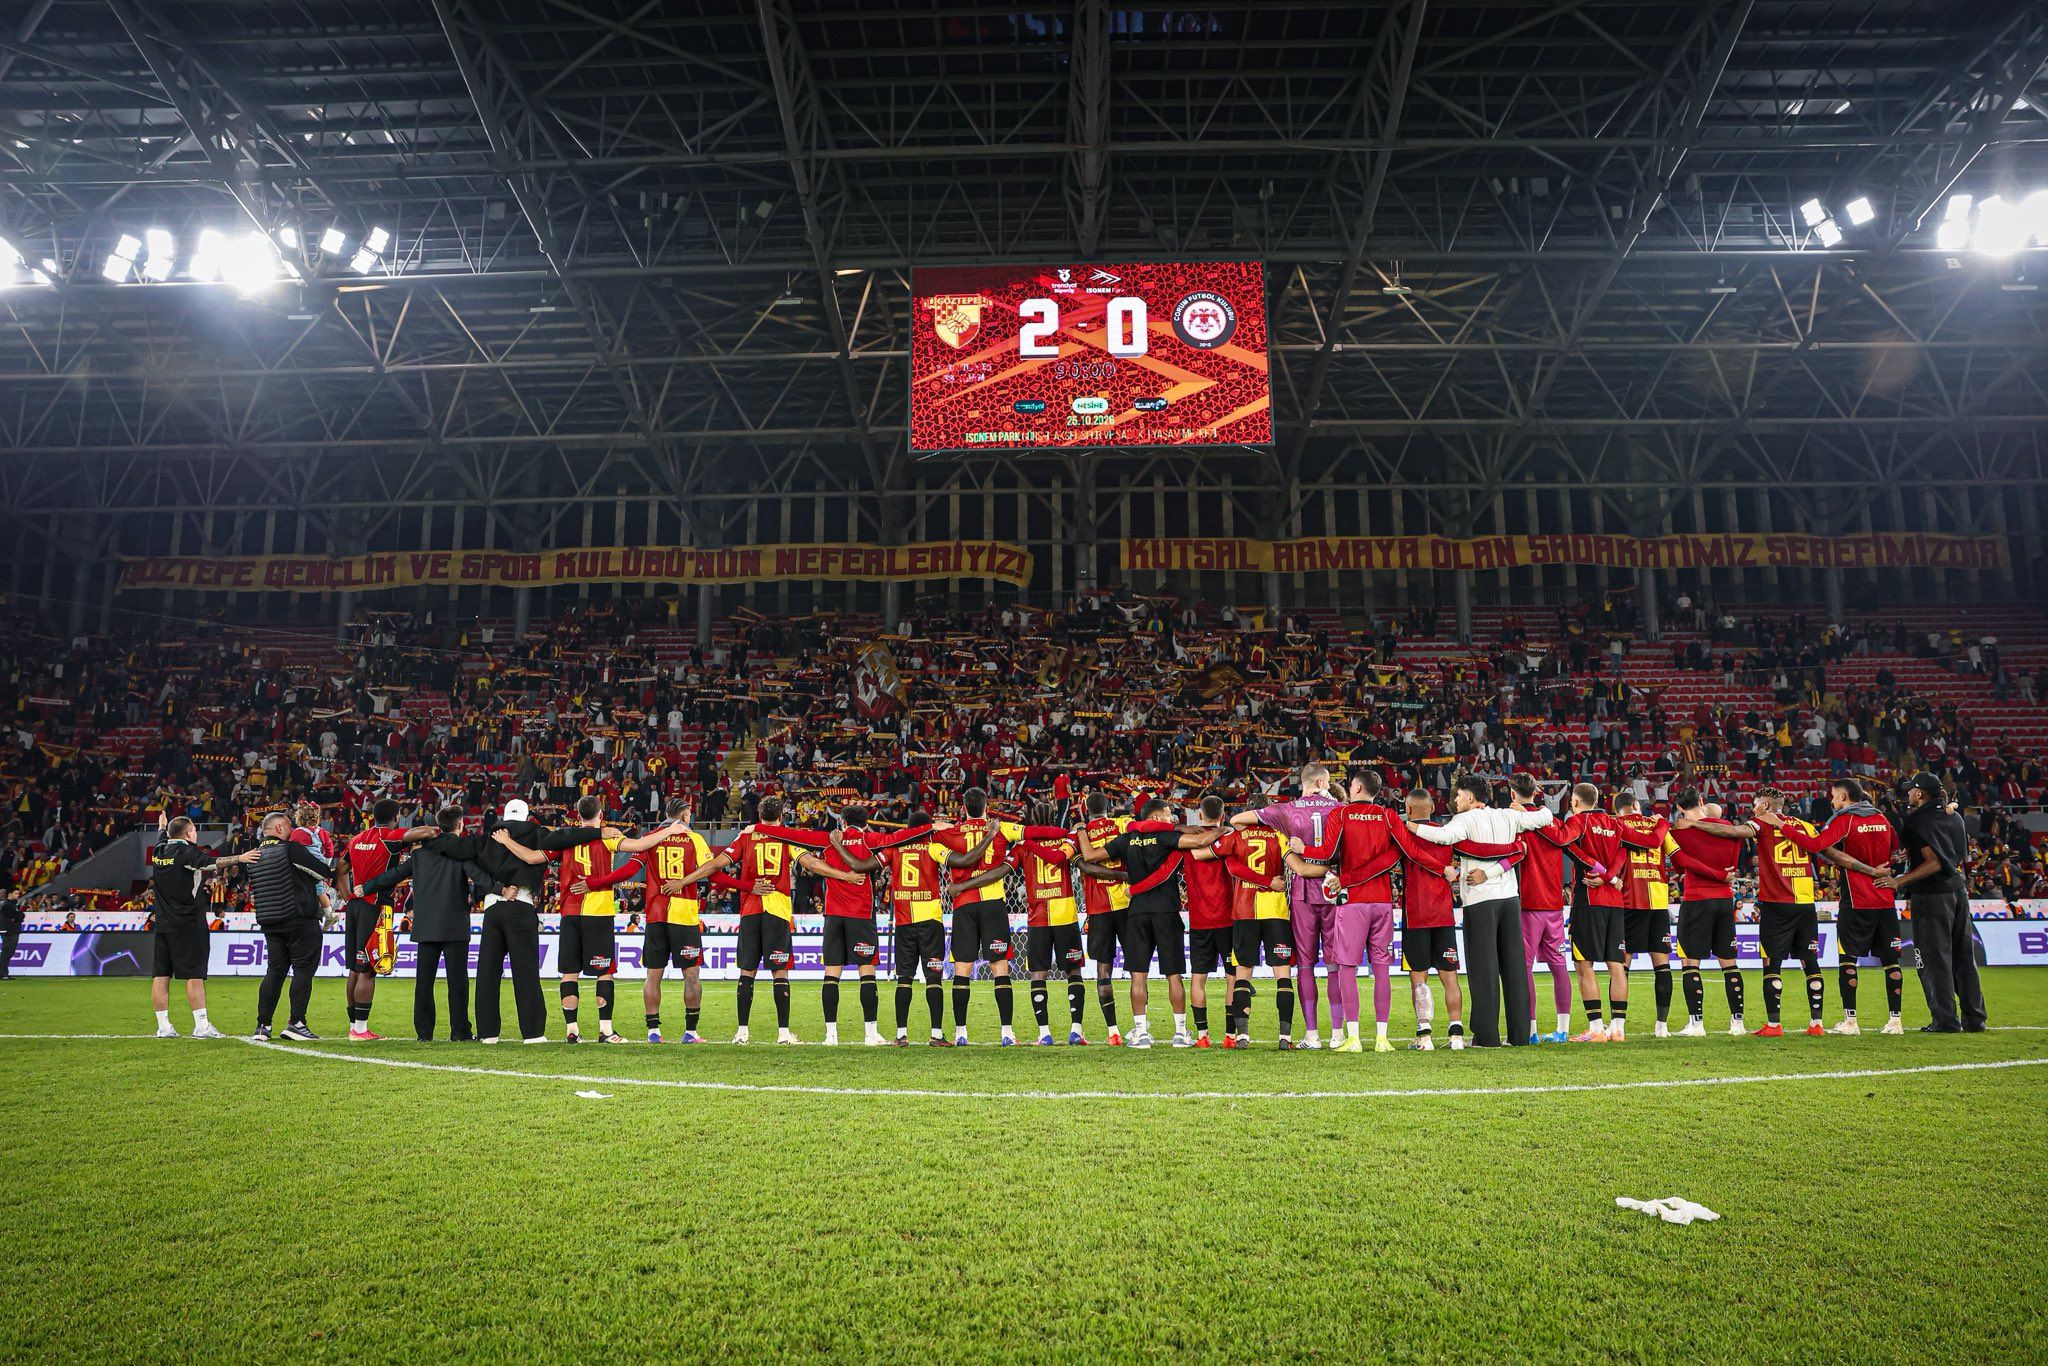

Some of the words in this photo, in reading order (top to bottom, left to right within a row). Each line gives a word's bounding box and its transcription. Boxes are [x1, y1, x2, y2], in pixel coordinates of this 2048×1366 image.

[1019, 298, 1059, 358] 2
[1106, 297, 1148, 358] 0
[410, 554, 452, 580] VE
[461, 553, 541, 581] SPOR
[1127, 539, 1260, 570] KUTSAL
[1272, 538, 1421, 571] ARMAYA
[1431, 538, 1519, 569] OLAN
[1310, 811, 1322, 847] 1
[1348, 813, 1383, 822] GÖZTEPE
[574, 845, 592, 876] 4
[656, 846, 685, 880] 18
[754, 842, 783, 876] 19
[901, 852, 920, 888] 6
[1247, 839, 1267, 875] 2
